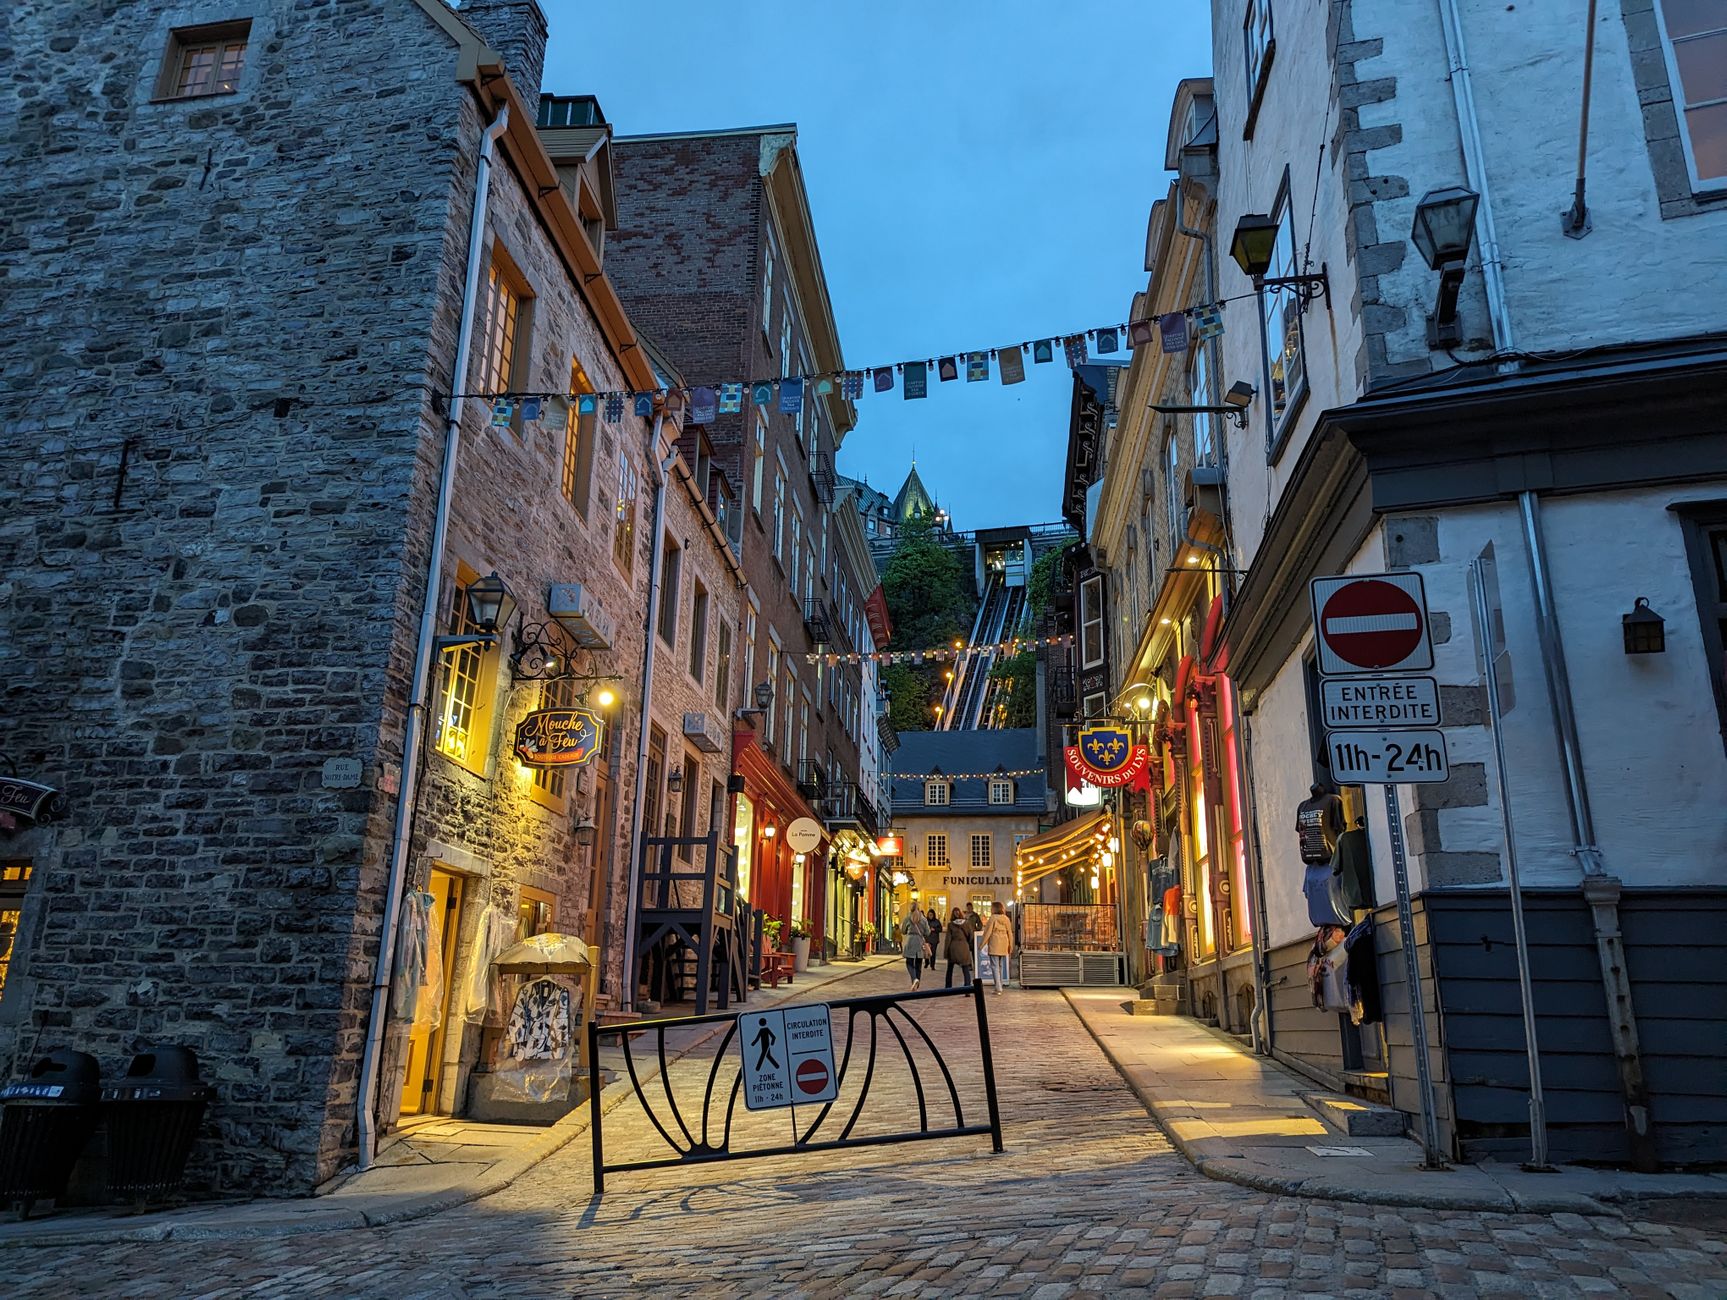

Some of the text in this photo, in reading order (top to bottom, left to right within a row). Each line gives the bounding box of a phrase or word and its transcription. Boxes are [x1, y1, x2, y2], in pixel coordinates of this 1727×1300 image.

[1341, 683, 1417, 701] ENTRÉE
[1331, 704, 1432, 720] INTERDITE
[525, 711, 583, 736] Mouche
[549, 731, 577, 749] Feu
[1067, 749, 1121, 784] SOUVENIRS
[1122, 767, 1136, 780] DU
[1132, 748, 1146, 769] LYS
[1, 785, 30, 804] Feu
[943, 876, 1014, 885] FUNICULAIR
[787, 1018, 827, 1029] CIRCULATION
[792, 1029, 824, 1040] INTERDITE
[759, 1073, 776, 1082] ZONE
[771, 1093, 784, 1101] 24h
